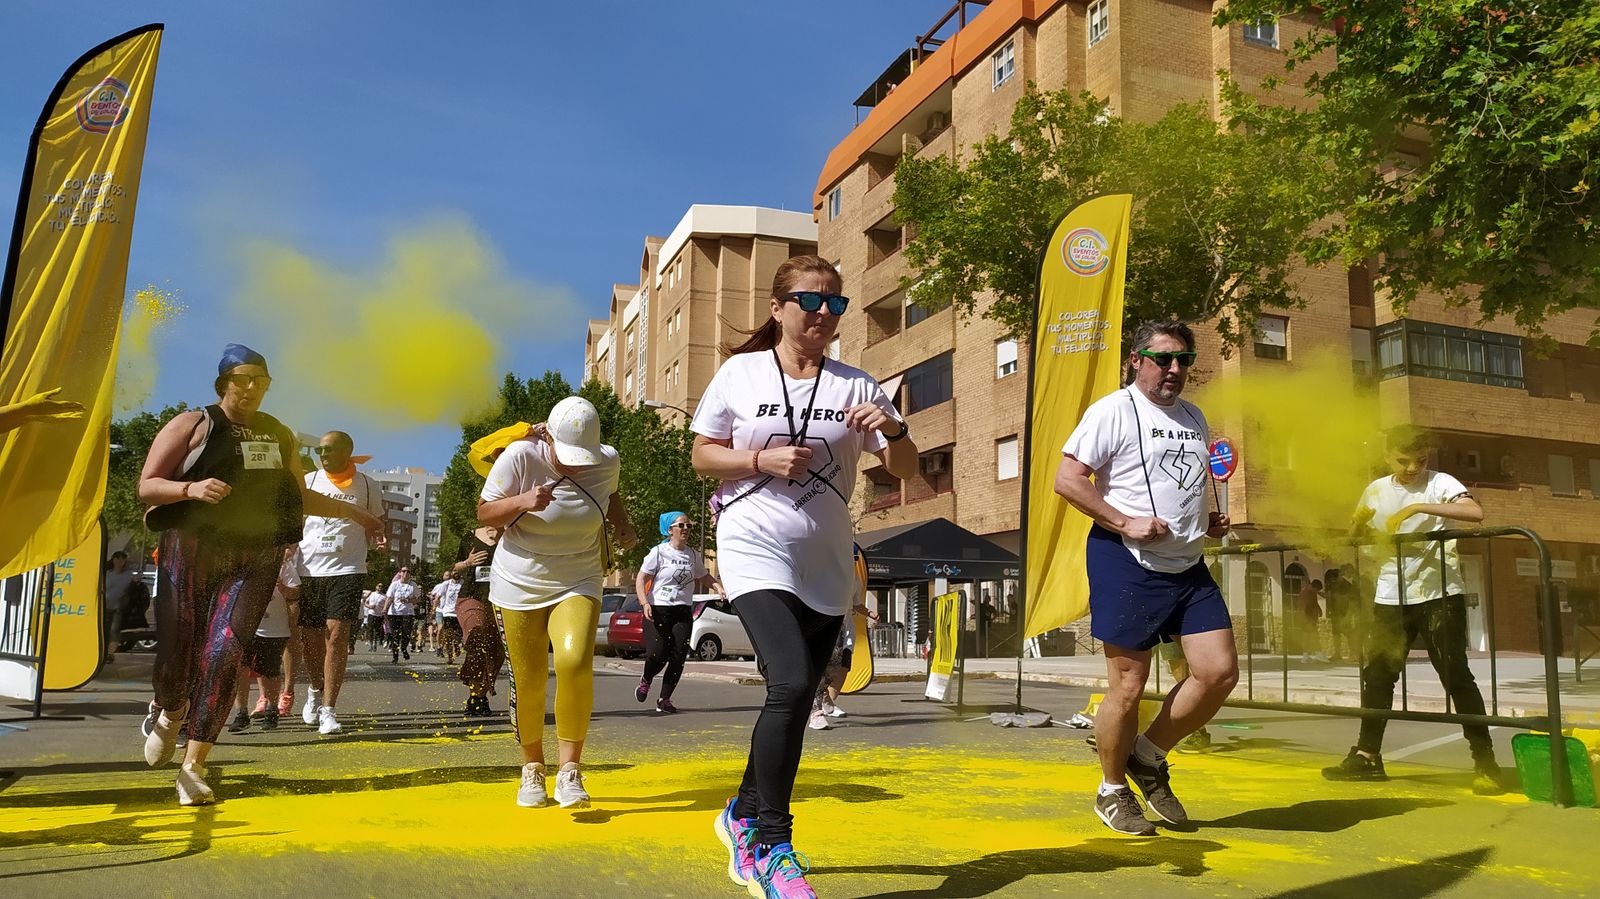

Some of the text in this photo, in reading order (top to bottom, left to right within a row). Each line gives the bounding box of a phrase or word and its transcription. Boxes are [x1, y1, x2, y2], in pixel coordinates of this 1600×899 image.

[71, 184, 127, 204] MMENTOS.
[59, 198, 113, 218] MULTIPLIC
[1047, 323, 1062, 333] TUS
[1051, 345, 1062, 354] TU
[756, 404, 780, 418] BE
[800, 408, 845, 422] HERO
[1152, 428, 1202, 441] BE A HERO
[251, 453, 266, 461] 281
[791, 488, 818, 511] CARRERA
